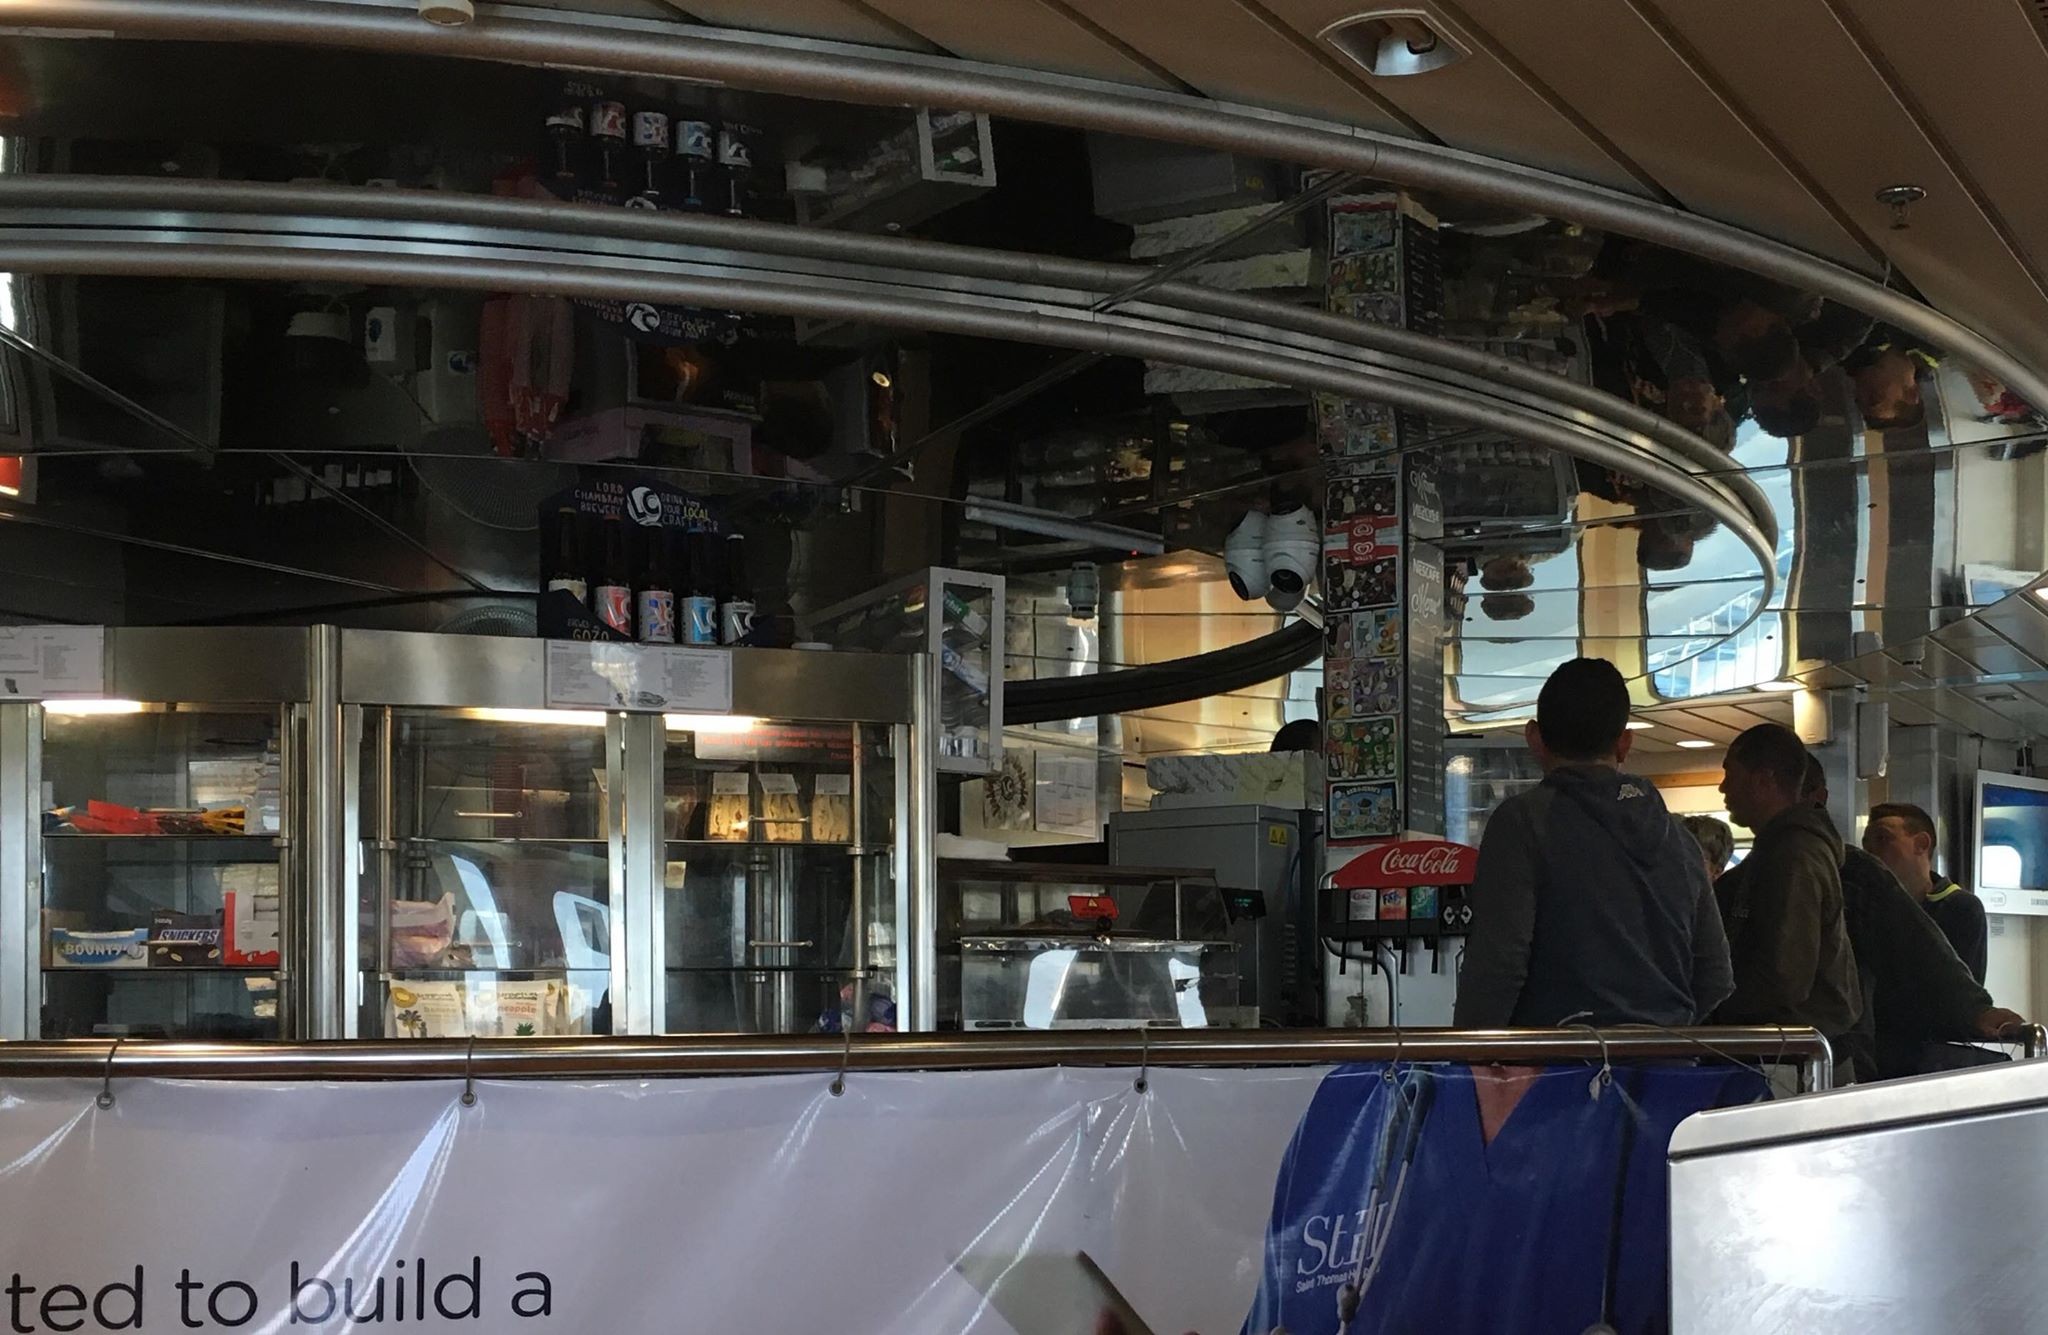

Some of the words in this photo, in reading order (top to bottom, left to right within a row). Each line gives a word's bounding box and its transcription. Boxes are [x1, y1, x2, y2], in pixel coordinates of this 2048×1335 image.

[596, 482, 624, 494] LORD
[574, 489, 626, 506] CHAMBRAY
[627, 487, 662, 523] LC
[683, 504, 710, 521] LOCAL
[572, 628, 610, 641] GOZO
[1381, 847, 1463, 875] Coca-Cola
[159, 929, 219, 943] SNICKERS
[65, 944, 121, 957] BOUNTY
[5, 1264, 144, 1334] ted
[174, 1268, 259, 1328] to
[290, 1255, 482, 1325] build
[510, 1271, 552, 1318] a
